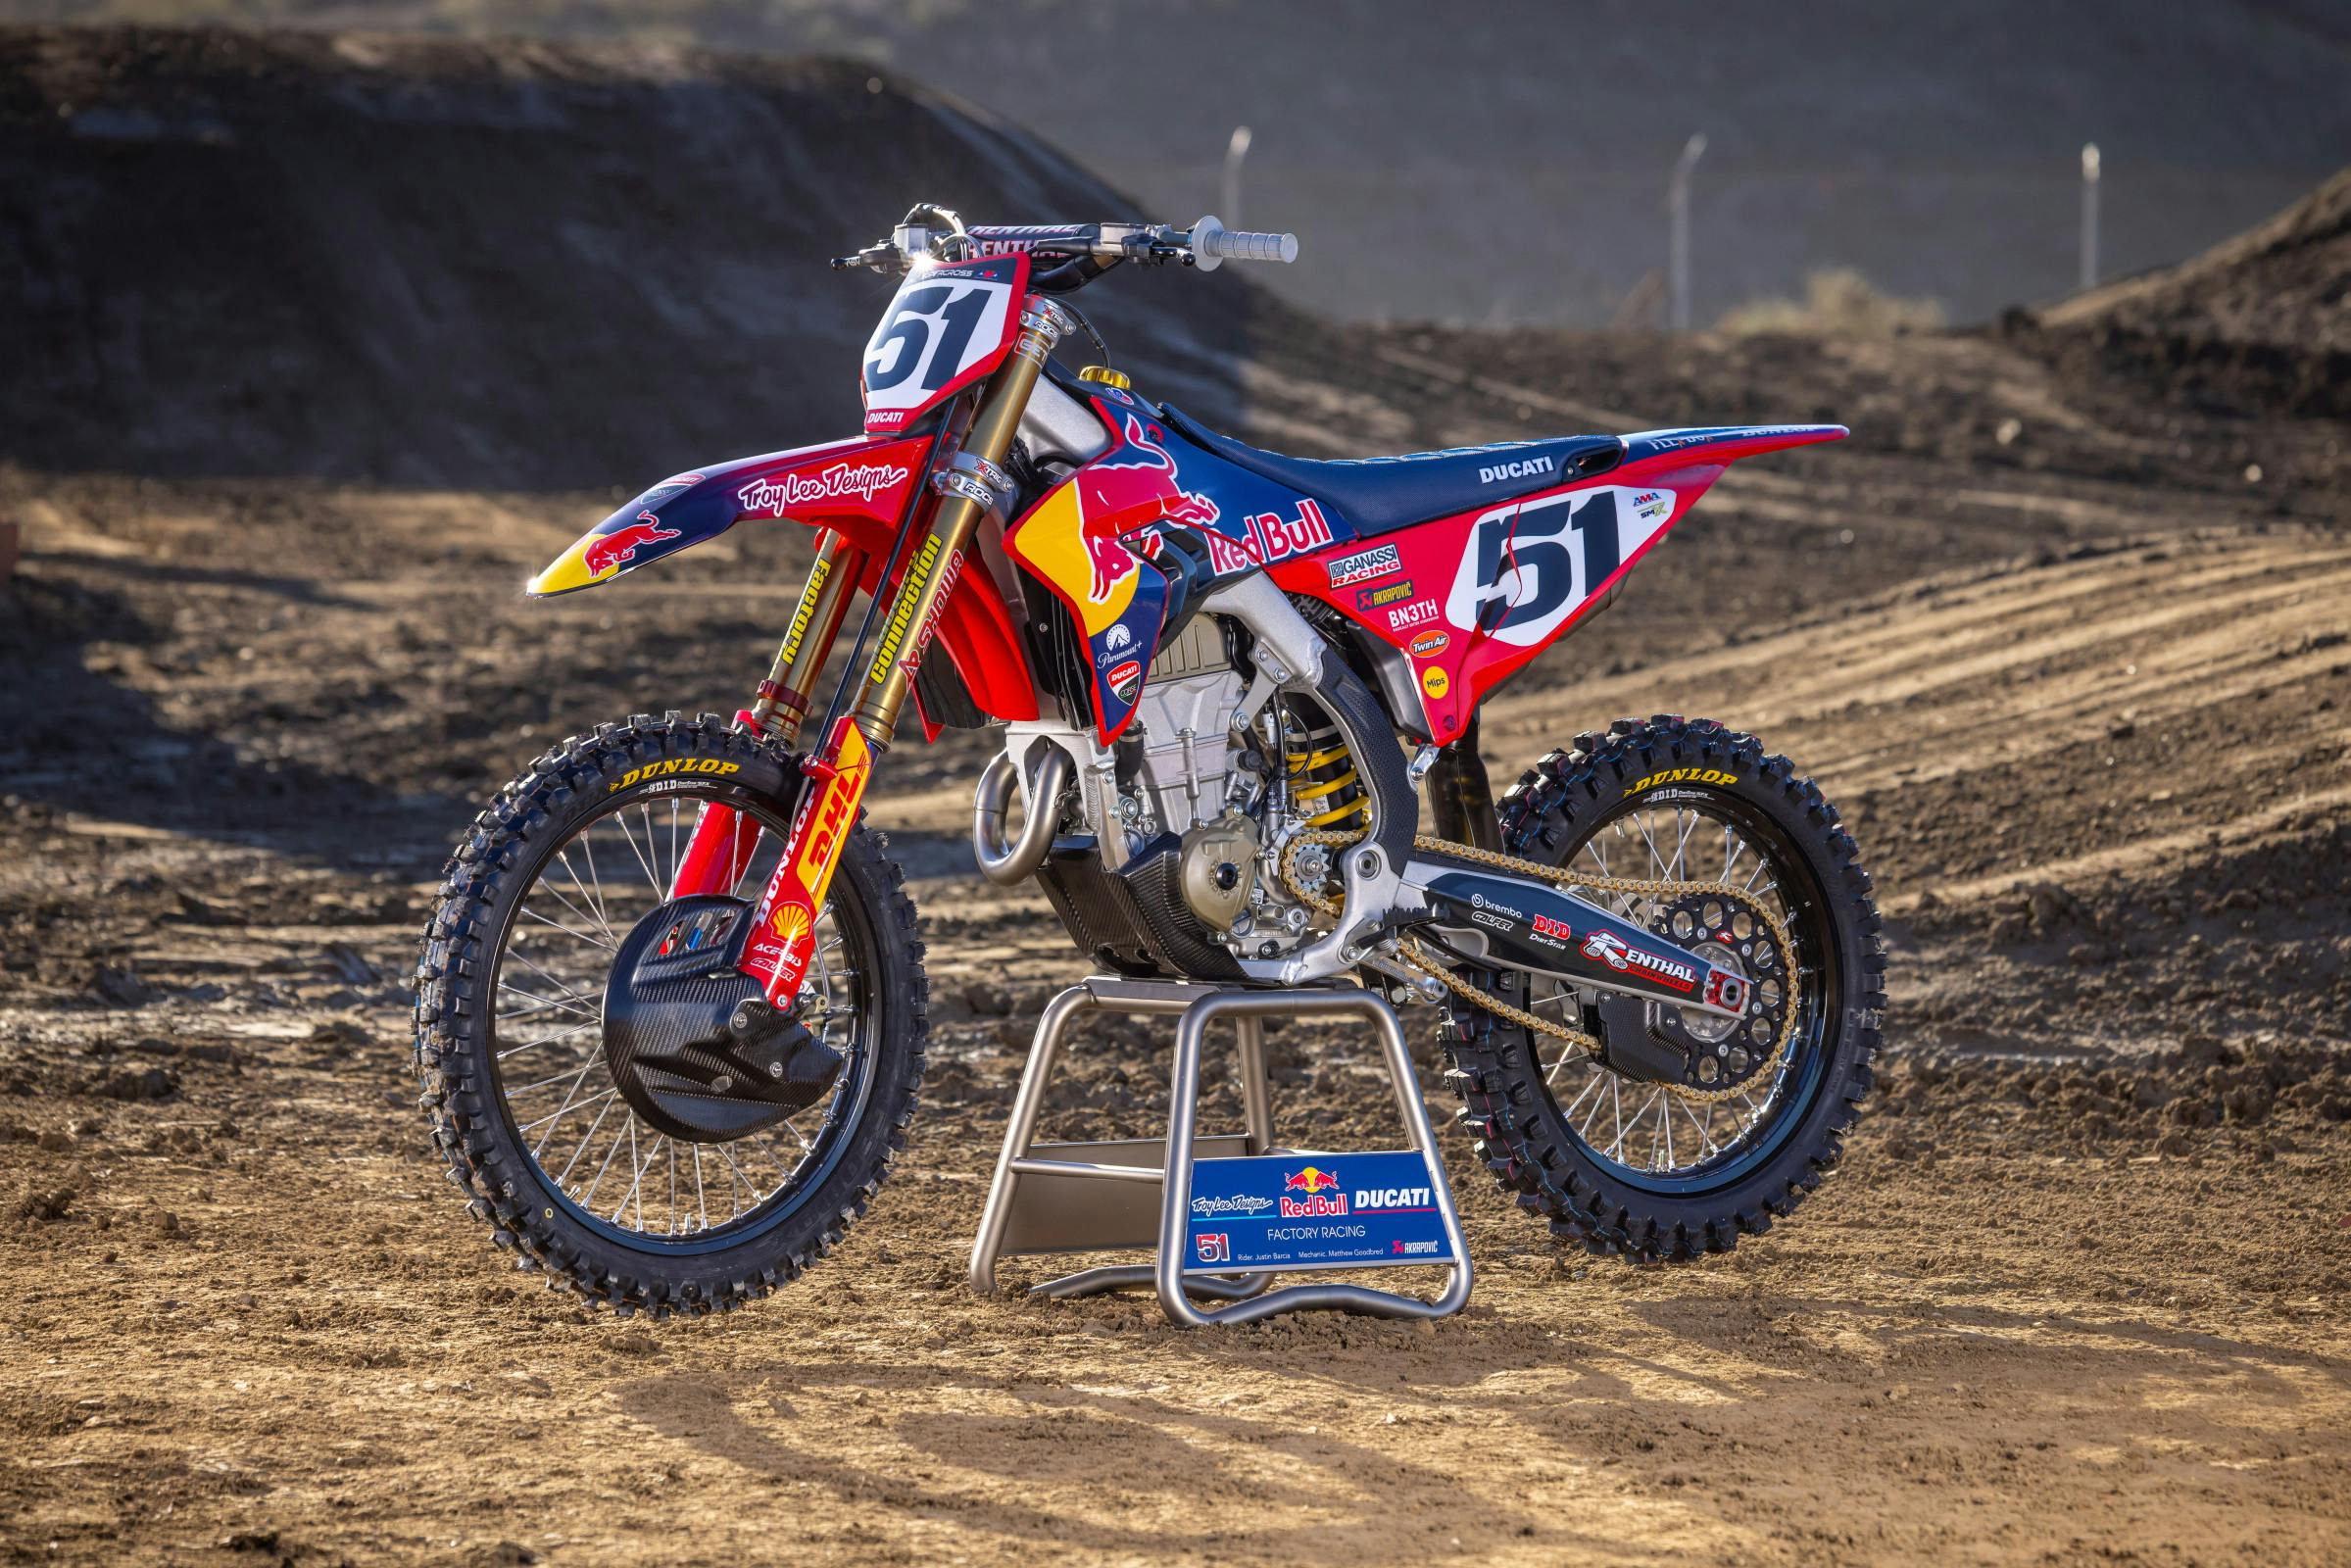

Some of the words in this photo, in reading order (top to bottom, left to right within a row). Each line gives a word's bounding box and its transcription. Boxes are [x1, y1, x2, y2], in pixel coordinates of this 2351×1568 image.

[867, 285, 993, 392] 51
[867, 411, 905, 424] DUCATI
[1479, 456, 1554, 484] DUCATI
[738, 478, 785, 517] Troy
[785, 473, 826, 504] Lee
[822, 463, 908, 503] Designs
[1633, 492, 1662, 508] AMA
[1204, 514, 1267, 577] Red
[1255, 498, 1334, 562] Bull
[1343, 547, 1398, 573] GANASSI
[1476, 491, 1621, 631] 51
[1332, 561, 1399, 587] RACING
[1388, 598, 1439, 628] BN3TH
[1412, 640, 1434, 654] Twin
[1111, 664, 1138, 682] DUCATI
[1426, 677, 1445, 689] Mips
[619, 758, 741, 789] DUNLOP
[1631, 767, 1739, 794] DUNLOP
[808, 772, 861, 870] DHL
[757, 787, 816, 928] DUNLOP
[1471, 910, 1514, 932] GALFER
[1485, 899, 1522, 918] brembo
[1532, 913, 1571, 941] DID
[1192, 1196, 1214, 1217] Troy
[1213, 1196, 1232, 1211] Lee
[1232, 1194, 1274, 1216] Designs
[1280, 1196, 1317, 1218] Red
[1316, 1193, 1348, 1217] Bull
[1355, 1187, 1430, 1208] DUCATI
[1267, 1227, 1319, 1241] FACTORY
[1321, 1225, 1366, 1239] RACING
[1196, 1233, 1231, 1263] 51
